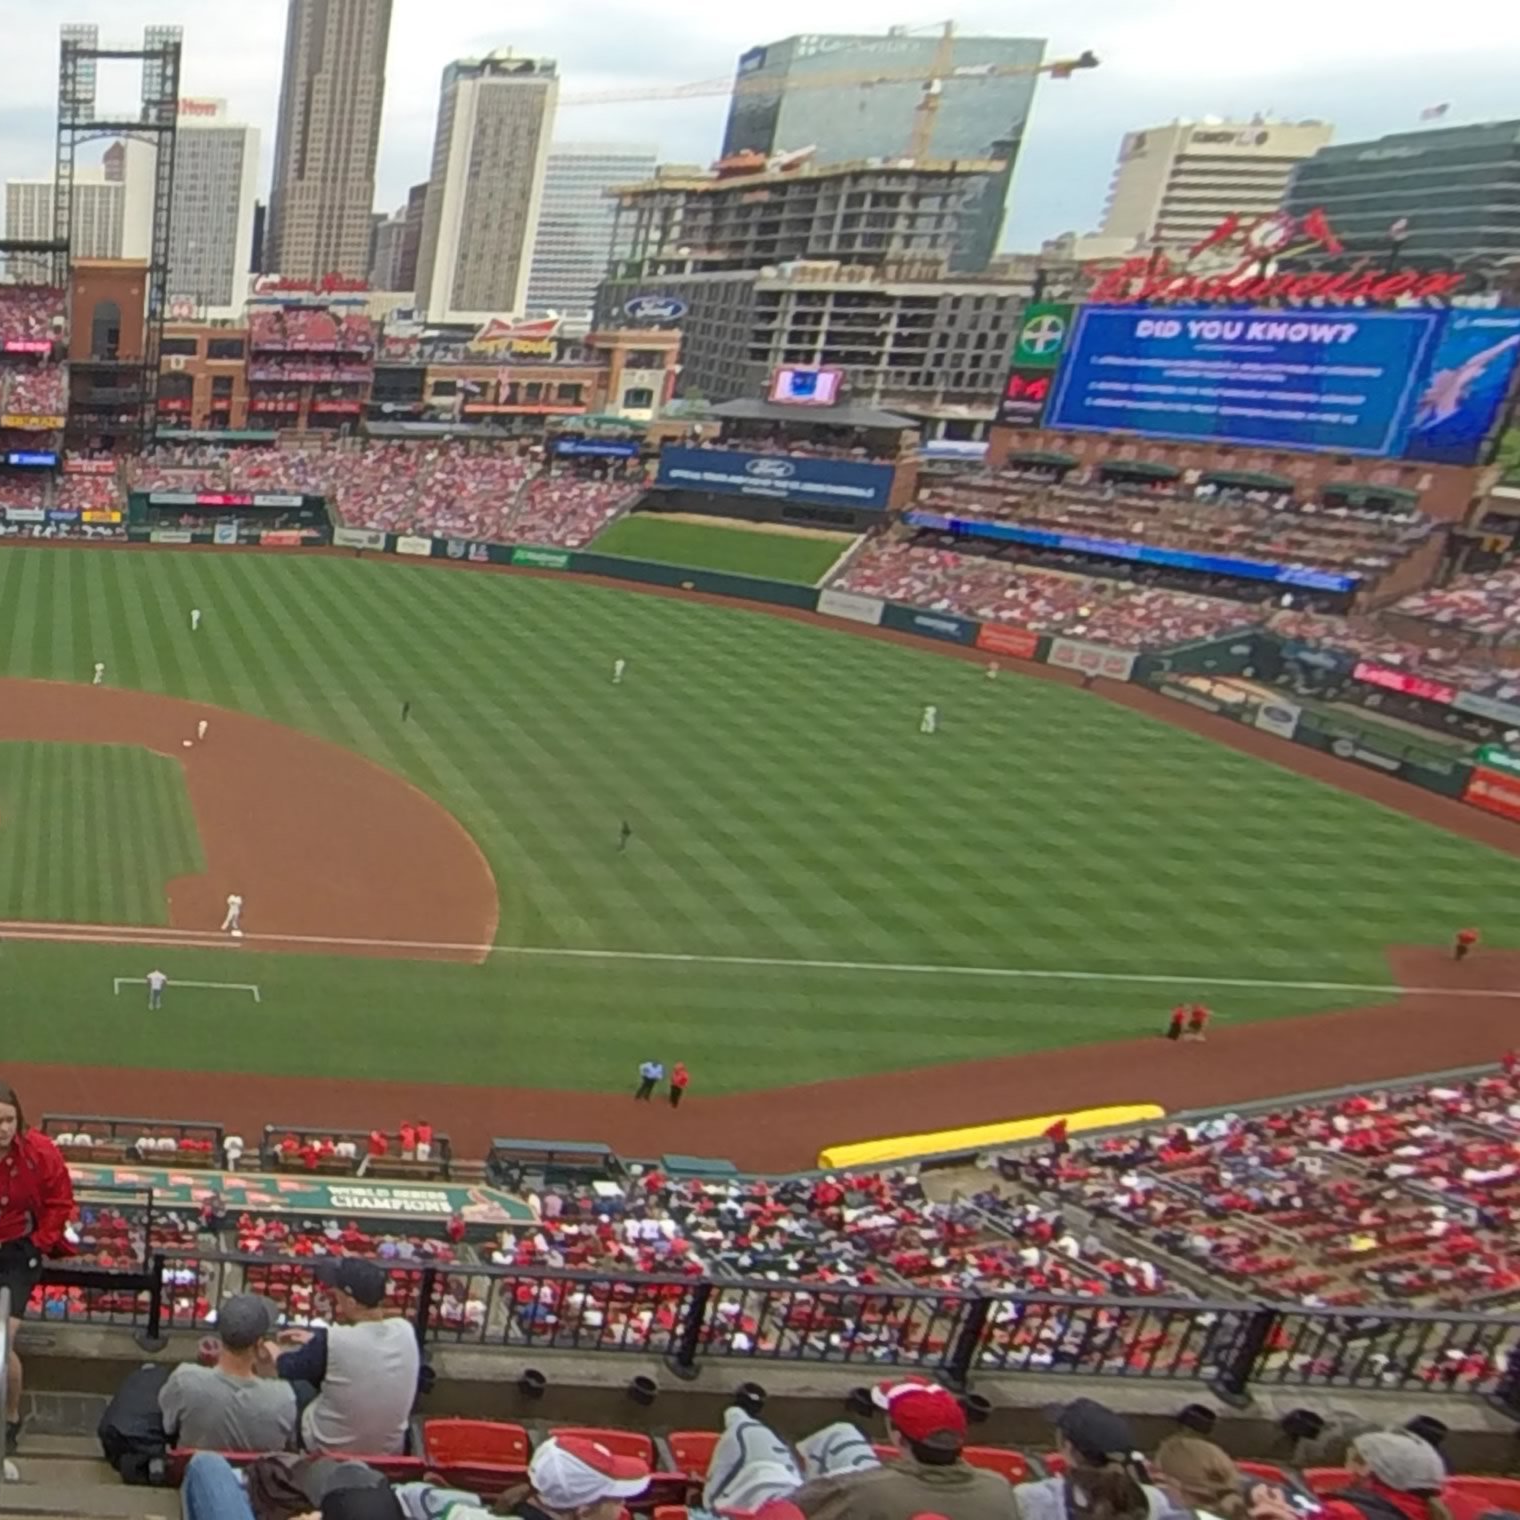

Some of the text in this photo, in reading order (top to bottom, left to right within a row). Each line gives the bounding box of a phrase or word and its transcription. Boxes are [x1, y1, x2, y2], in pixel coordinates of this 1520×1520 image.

[1136, 319, 1357, 343] DID YOU KNOW?
[330, 1195, 453, 1213] CHAMPIONS
